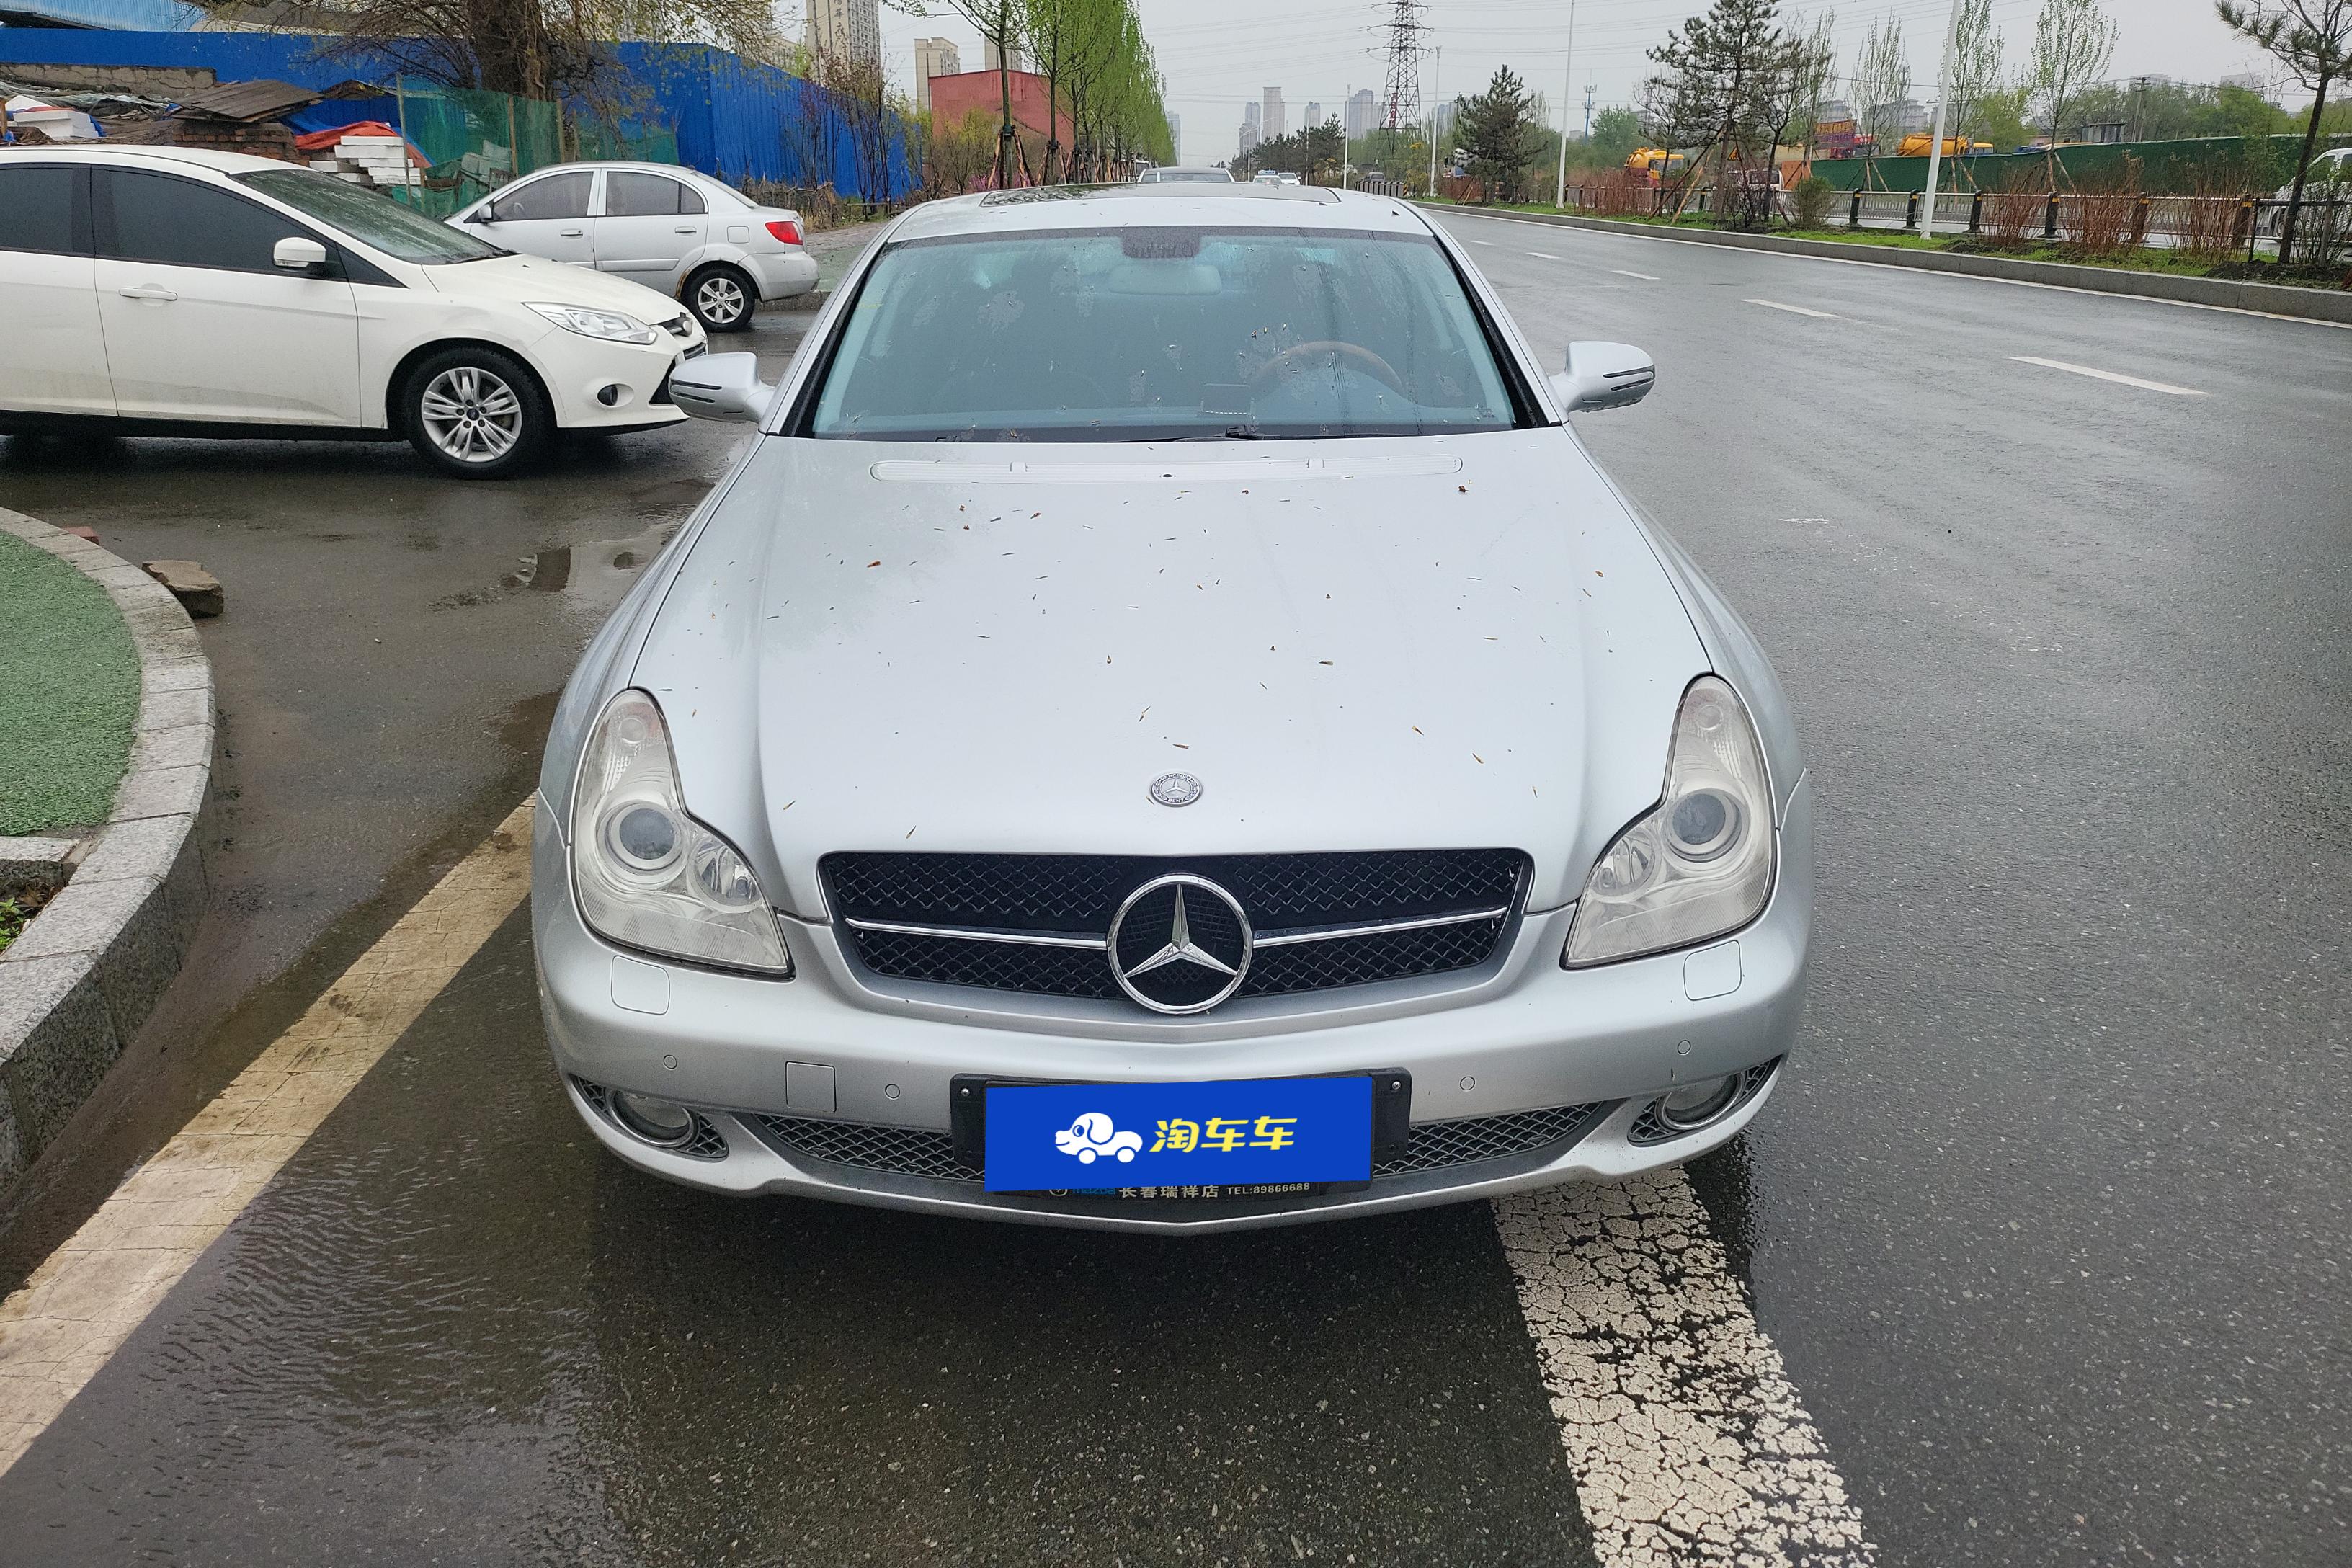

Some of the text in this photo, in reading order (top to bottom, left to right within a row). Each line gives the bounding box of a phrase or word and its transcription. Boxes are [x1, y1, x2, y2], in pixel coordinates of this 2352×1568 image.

[1118, 1185, 1219, 1198] 长春瑞祥店
[1226, 1182, 1310, 1195] TEL:89866688
